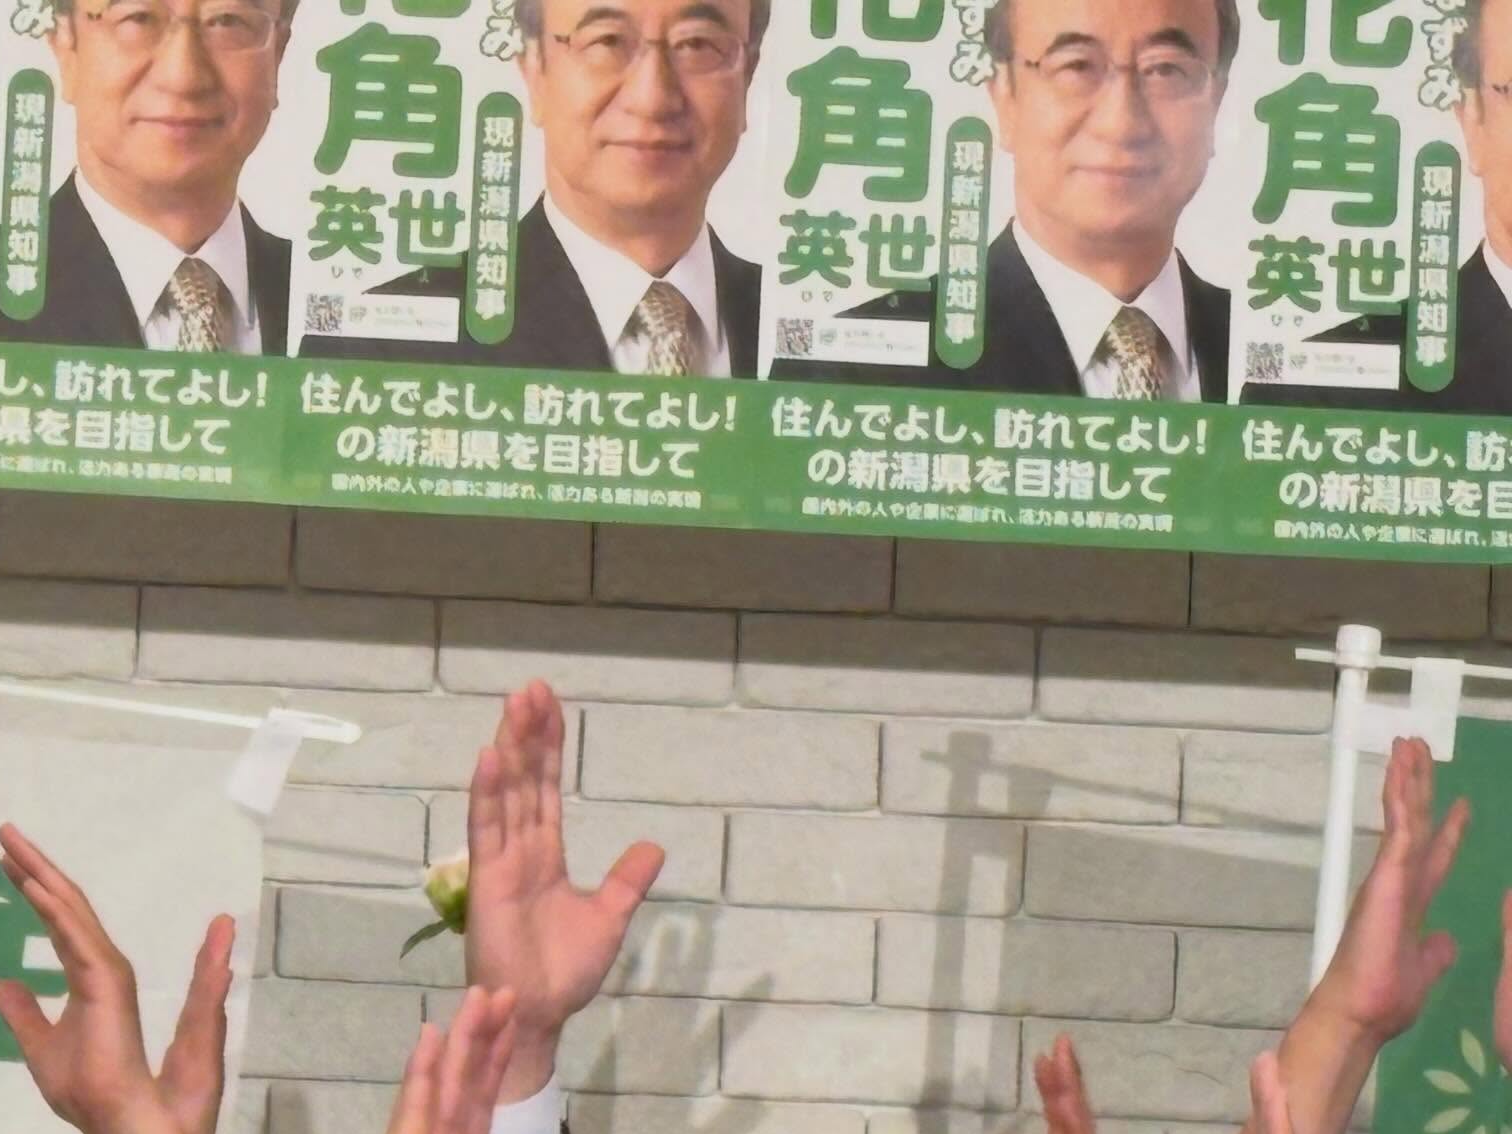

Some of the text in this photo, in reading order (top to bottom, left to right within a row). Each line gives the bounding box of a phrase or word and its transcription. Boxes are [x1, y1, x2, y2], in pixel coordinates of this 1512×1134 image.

[313, 0, 472, 178] 角
[1418, 0, 1467, 111] ずみ
[780, 0, 945, 203] 角
[308, 185, 466, 267] 英世
[778, 209, 936, 291] 英世
[1248, 234, 1406, 316] 英世
[336, 424, 700, 478] の新潟県を目指して
[807, 448, 1171, 502] の新潟県を目指して
[1242, 419, 1512, 472] 住んでよし、訪
